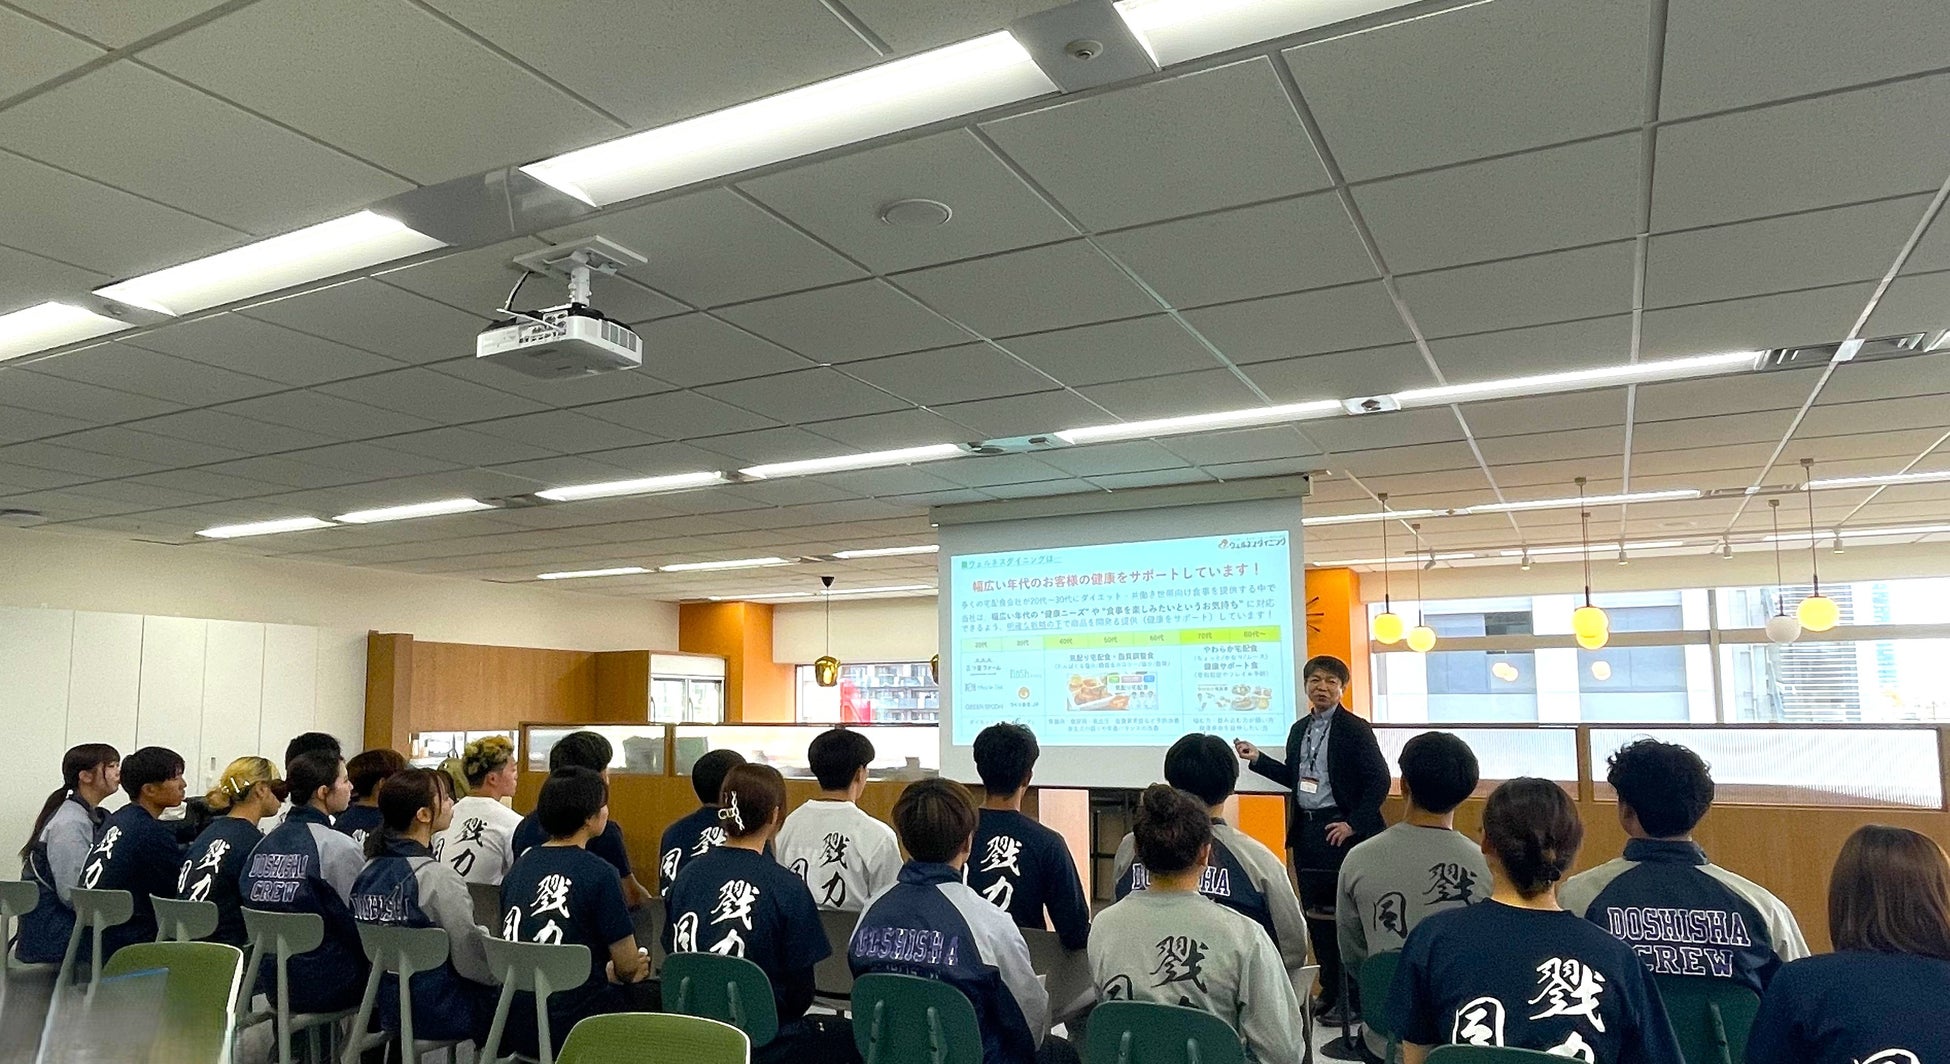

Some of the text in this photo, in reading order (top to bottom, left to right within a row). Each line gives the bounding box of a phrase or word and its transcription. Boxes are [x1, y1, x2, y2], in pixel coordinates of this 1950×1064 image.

[972, 562, 1259, 592] 幅広い年代のお客様の健康をサポートしています！
[250, 880, 301, 903] CREW
[1607, 906, 1752, 947] DOSHISHA
